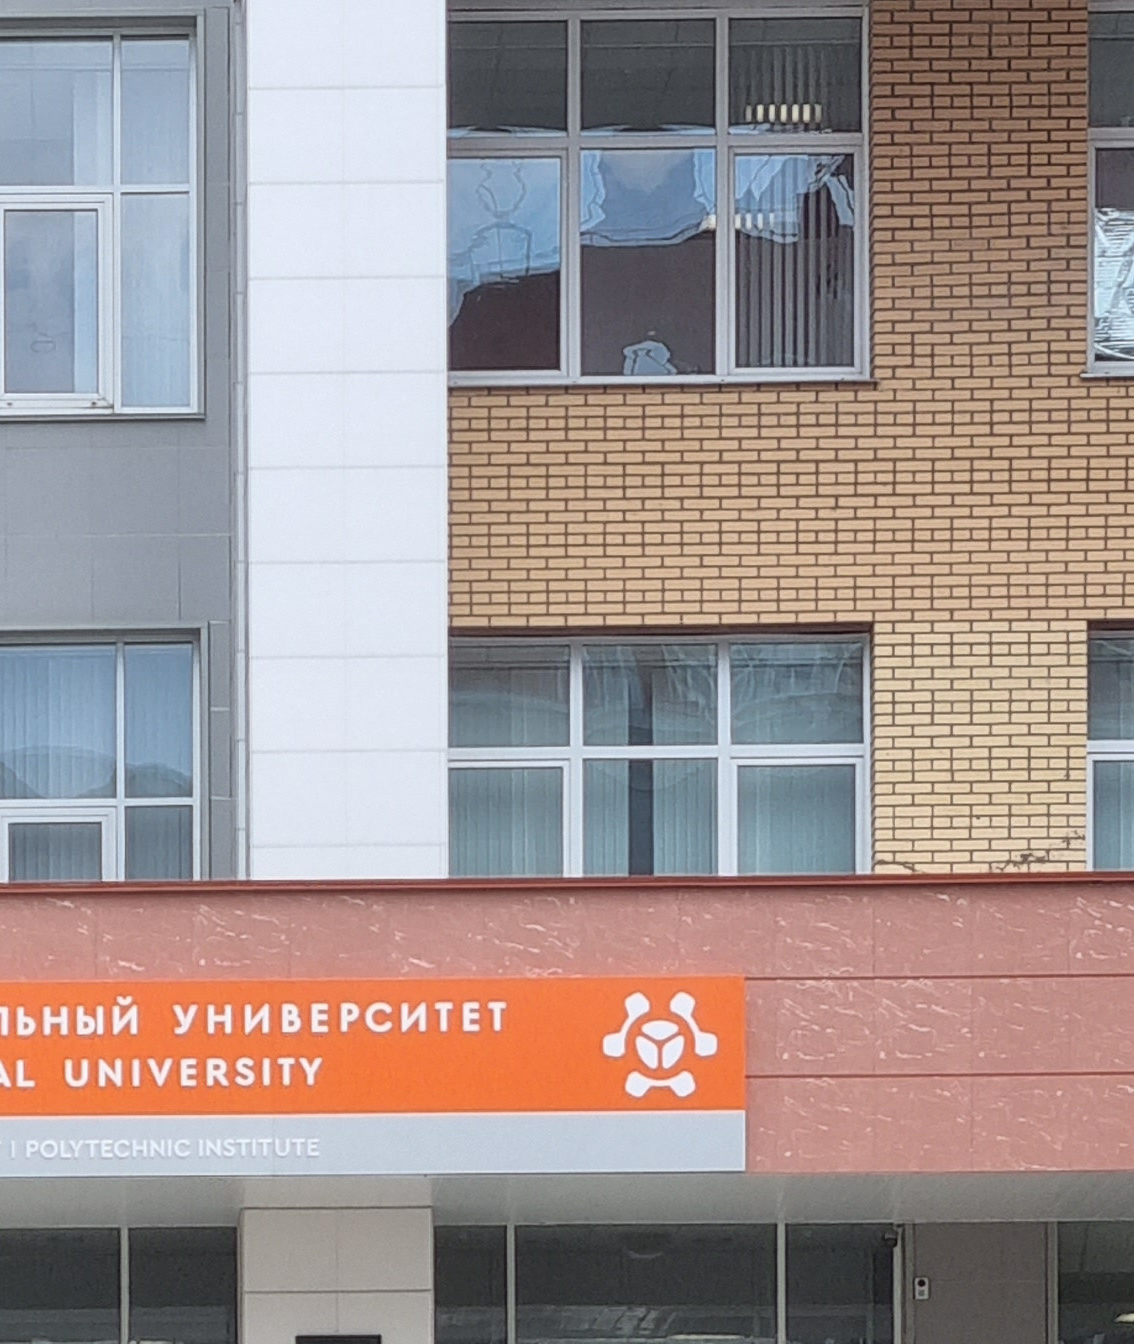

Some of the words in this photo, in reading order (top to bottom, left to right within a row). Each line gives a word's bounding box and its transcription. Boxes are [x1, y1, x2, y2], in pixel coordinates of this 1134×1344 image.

[173, 1001, 507, 1036] УНИВЕРСИТЕТ
[64, 1056, 323, 1088] UNIVERSITY
[26, 1138, 191, 1160] POLYTECHNIC
[198, 1137, 321, 1158] INSTITUTE
